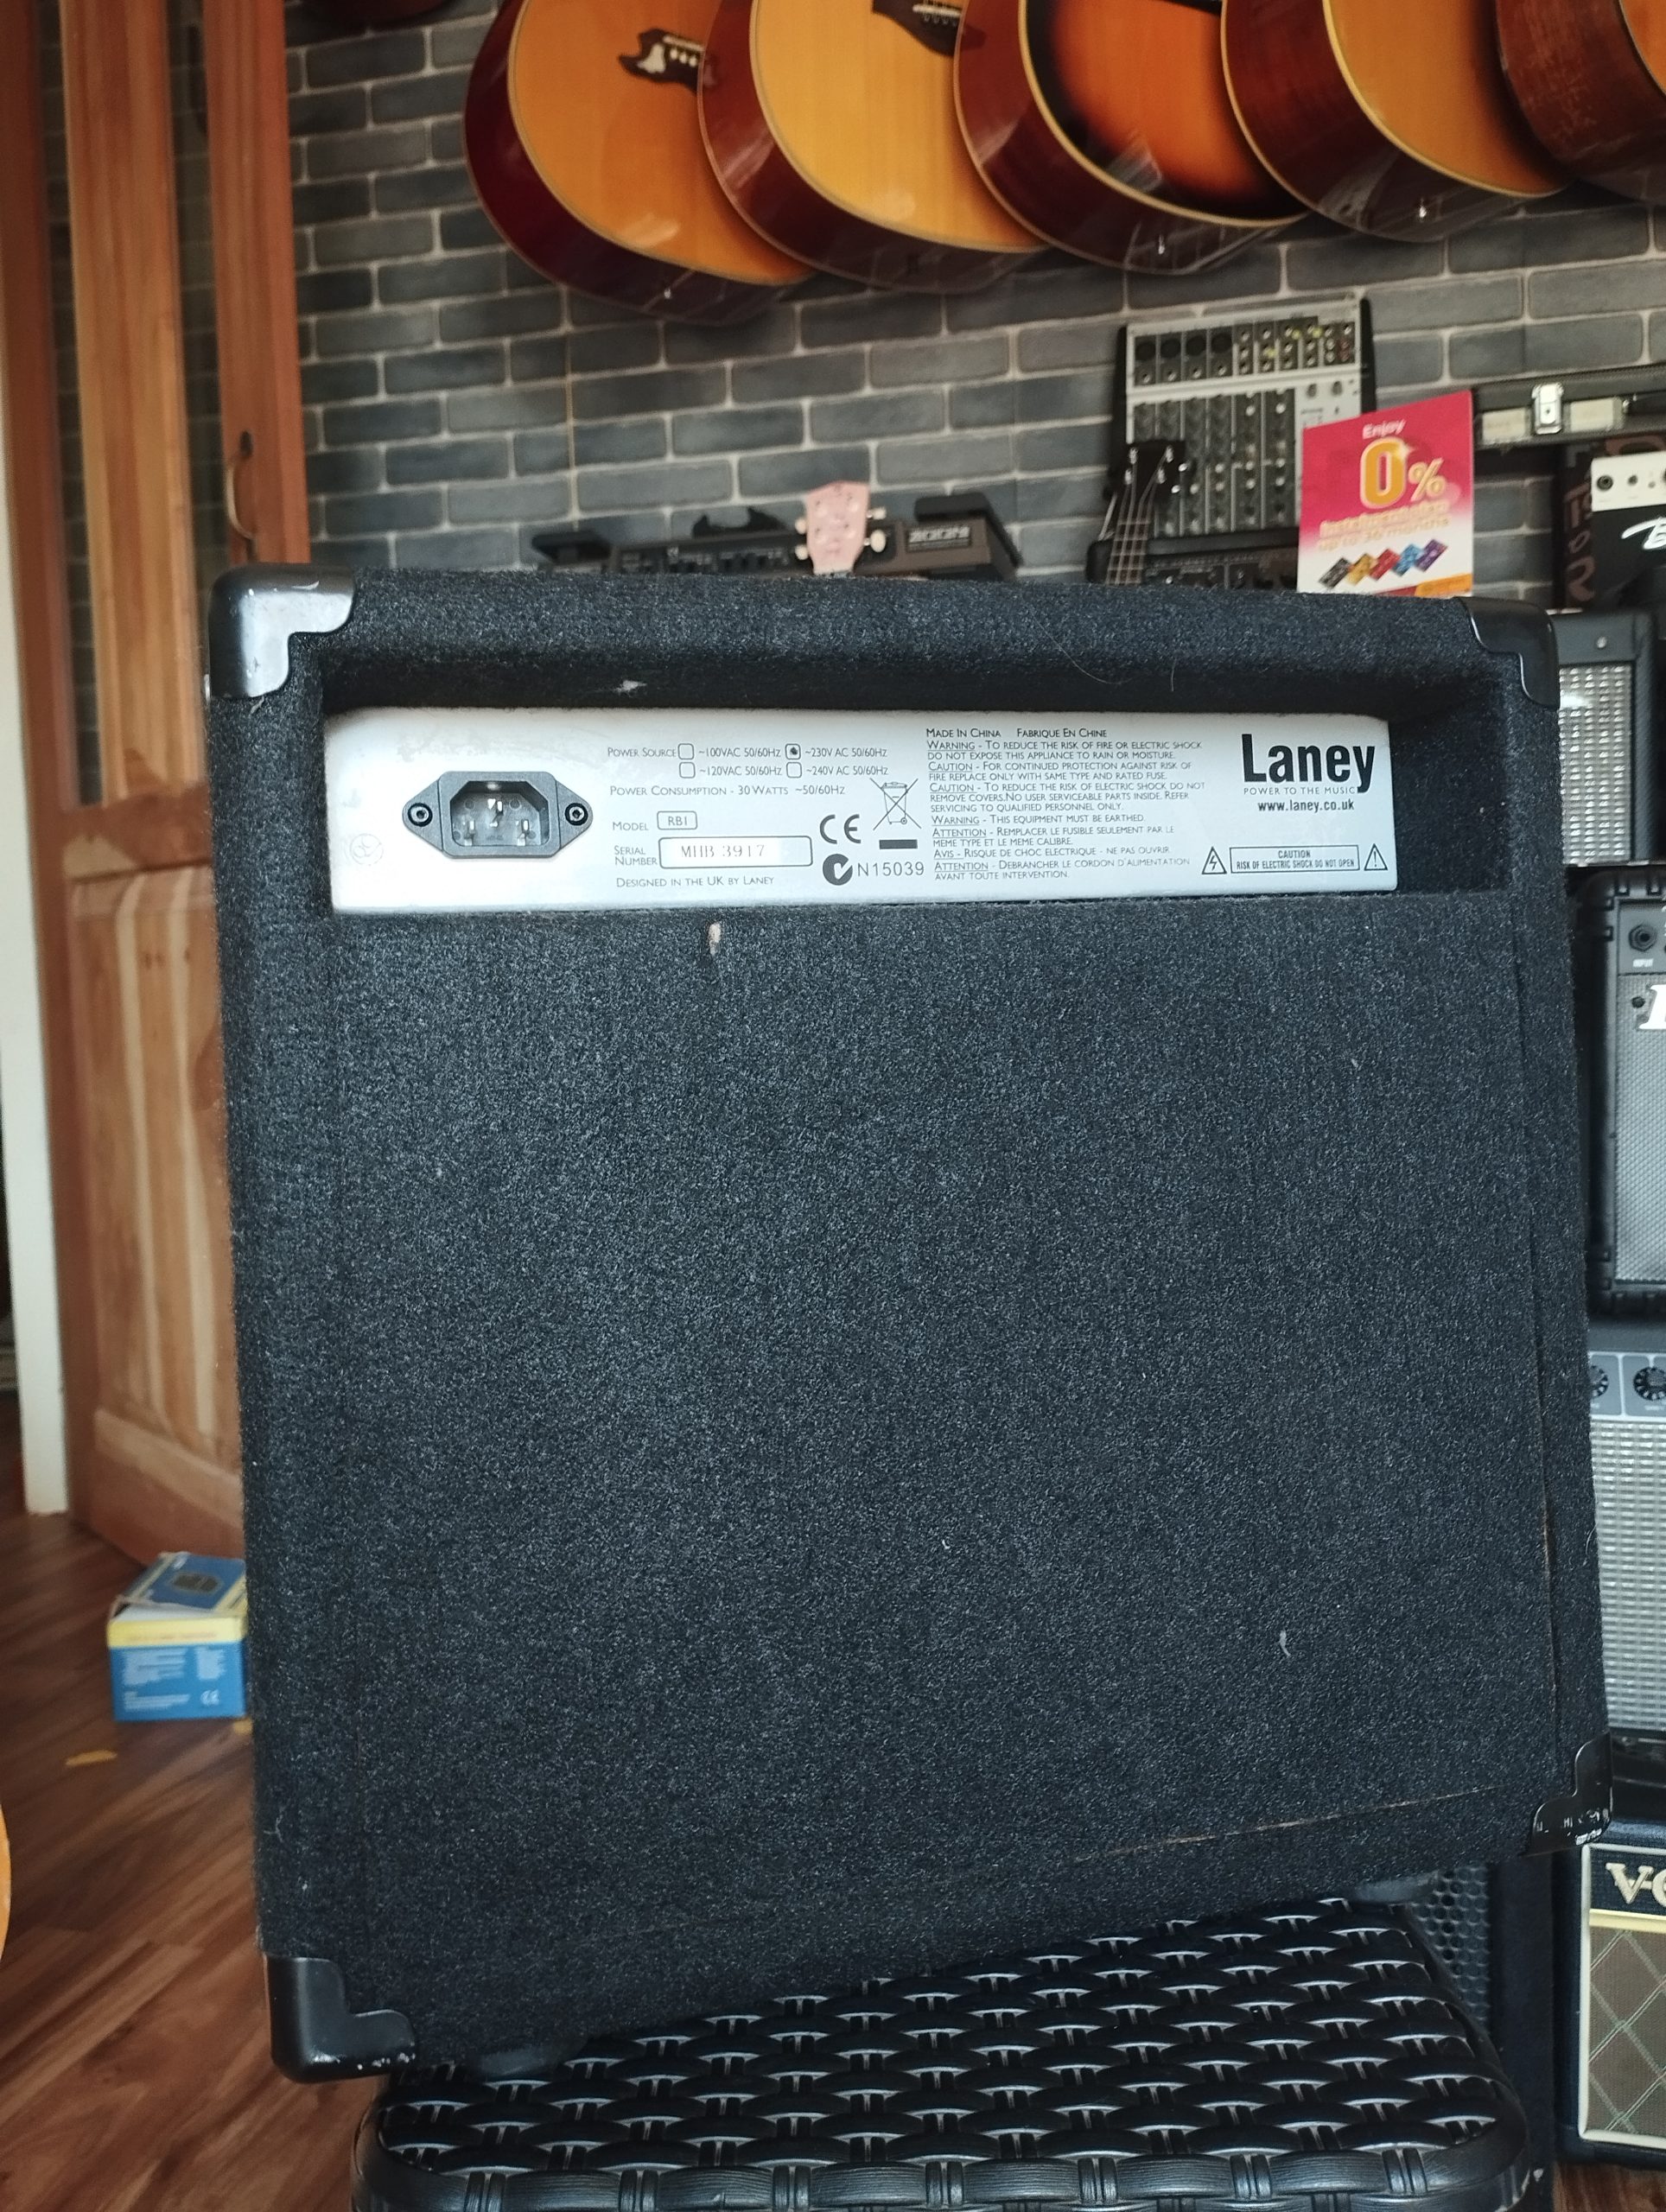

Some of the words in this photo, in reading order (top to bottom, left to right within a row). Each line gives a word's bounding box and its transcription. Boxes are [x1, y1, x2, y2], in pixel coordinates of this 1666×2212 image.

[1362, 419, 1407, 439] Enjoy
[1360, 436, 1447, 508] 0%
[926, 728, 953, 738] MADE
[957, 728, 967, 738] IN
[970, 728, 1002, 738] CHINA
[1017, 728, 1059, 739] FABRIQUE
[1063, 728, 1076, 737] EN
[1079, 728, 1107, 737] CHINE
[927, 741, 975, 750] WARNING
[985, 741, 1000, 749] TO
[1003, 741, 1038, 750] REDUCE
[607, 747, 639, 757] POWER
[642, 747, 677, 758] SOURCE
[835, 747, 849, 757] AC
[928, 761, 972, 771] CAUTION
[982, 761, 1002, 771] FOR
[1242, 734, 1375, 793] Laney
[836, 766, 849, 775] AC
[989, 772, 1014, 781] ONLY
[610, 785, 647, 795] POWER
[651, 785, 727, 795] CONSUMPTION
[738, 785, 750, 795] 30
[752, 785, 788, 795] WATTS
[930, 783, 974, 792] CAUTION
[984, 782, 999, 791] TO
[996, 804, 1042, 812] QUALIFIED
[1045, 803, 1094, 811] PERSONNEL
[1257, 798, 1355, 813] www.laney.co.uk
[932, 816, 979, 824] WARNING
[989, 815, 1010, 823] THIS
[1014, 815, 1063, 824] EQUIPMENT
[612, 822, 649, 830] MODEL
[932, 828, 987, 837] ATTENTION
[997, 827, 1047, 836] REMPLACER
[614, 845, 646, 855] SERIAL
[934, 849, 954, 858] AVIS
[964, 849, 996, 858] RISQUE
[1045, 848, 1097, 856] ELECTRIQUE
[1278, 850, 1311, 859] CAUTION
[615, 856, 658, 866] NUMBER
[935, 862, 989, 871] ATTENTION
[999, 860, 1059, 869] DEBRANCHER
[1237, 861, 1250, 869] RISK
[1252, 861, 1260, 869] OF
[1262, 860, 1291, 869] ELECTRIC
[1293, 860, 1313, 868] SHOCK
[1325, 859, 1337, 868] NOT
[1339, 859, 1355, 868] OPEN
[857, 861, 925, 877] N15039
[616, 877, 667, 887] DESIGNED
[707, 876, 724, 886] UK
[728, 877, 739, 886] BY
[743, 875, 775, 886] LANEY
